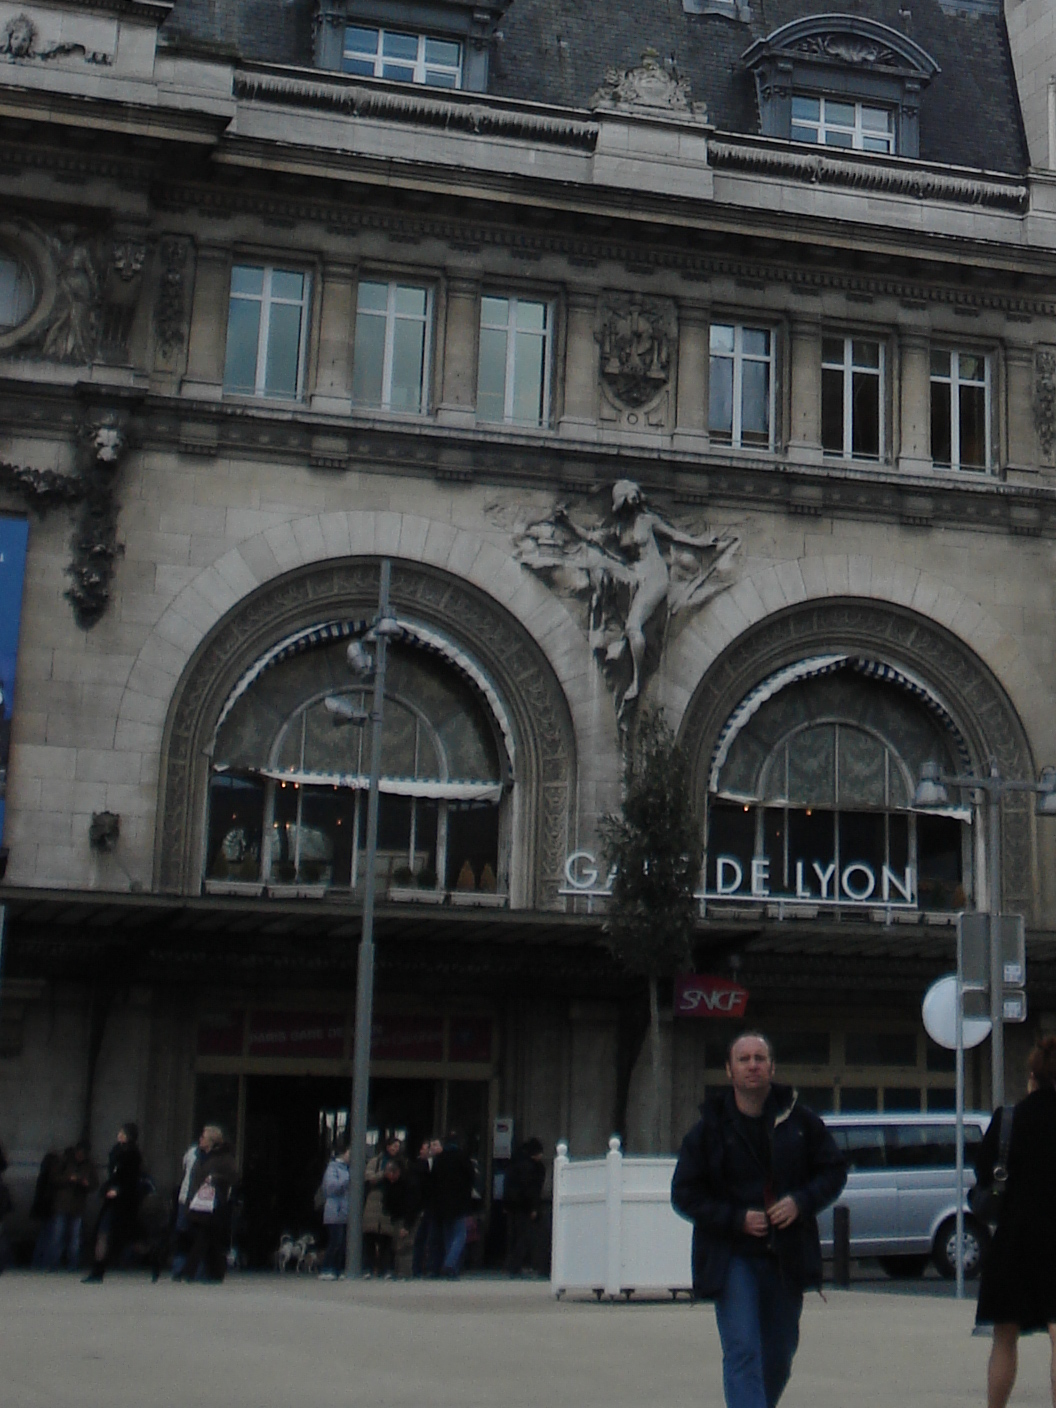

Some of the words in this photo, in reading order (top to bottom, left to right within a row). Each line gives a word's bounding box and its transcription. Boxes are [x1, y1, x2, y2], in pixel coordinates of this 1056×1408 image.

[716, 857, 771, 898] DE
[796, 861, 914, 904] LYON
[679, 989, 747, 1011] SNCF
